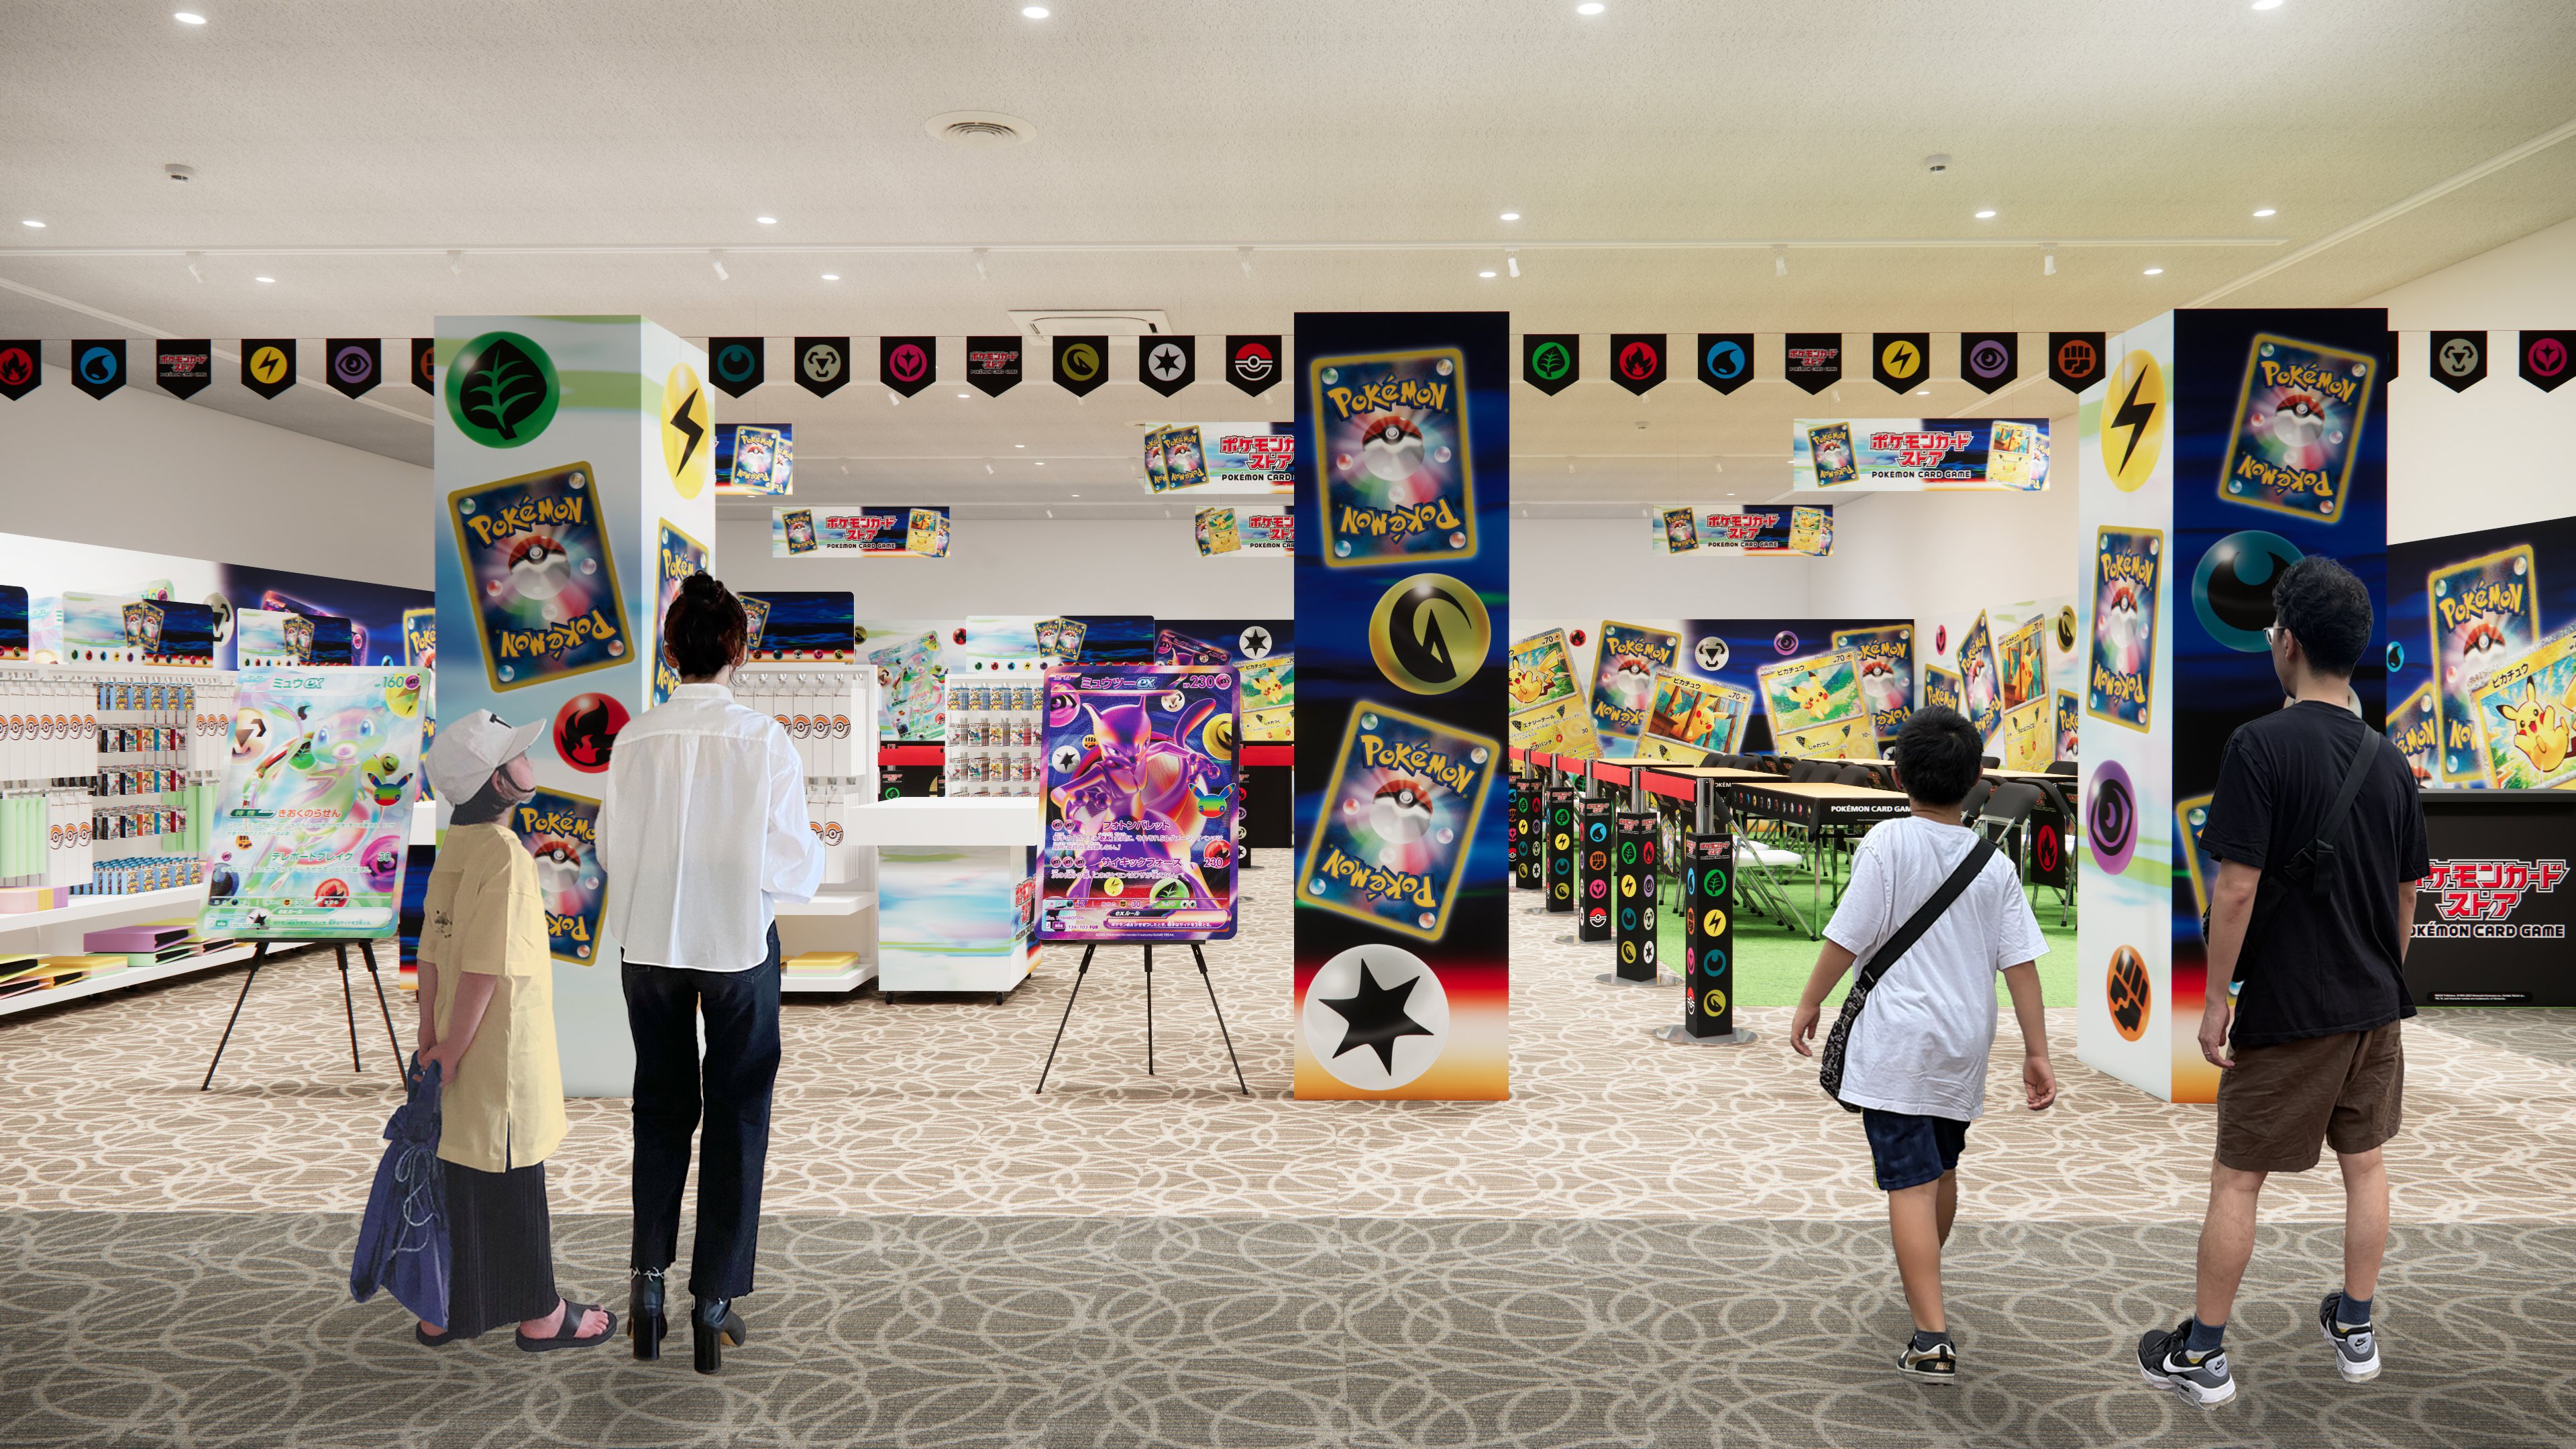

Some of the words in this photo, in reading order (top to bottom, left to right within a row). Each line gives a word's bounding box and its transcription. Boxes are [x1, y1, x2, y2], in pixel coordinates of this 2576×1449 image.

[160, 354, 208, 364] ポケモンカード
[969, 352, 1018, 361] ポケモンカード
[1788, 348, 1838, 358] ポケモンカード
[172, 363, 195, 372] ストア
[982, 360, 1006, 369] ストア
[1801, 358, 1825, 366] ストア
[1220, 435, 1294, 453] ポケモンカ
[1869, 431, 1974, 451] ポケモンカード
[1246, 453, 1294, 470] ストア
[1895, 450, 1946, 468] ストア
[1222, 472, 1264, 481] POKÉMON
[1872, 469, 1915, 478] POKÉMON
[1945, 470, 1972, 478] GAME
[825, 516, 896, 529] ポケモンカード
[1707, 514, 1780, 527] ポケモンカード
[843, 529, 879, 541] ストア
[1267, 527, 1294, 541] スト
[1725, 527, 1760, 540] ストア
[1777, 665, 1805, 676] ピカチュウ
[2492, 663, 2529, 689] ピカチュウ
[383, 676, 404, 689] 160
[1081, 677, 1158, 690] ミュウツーex
[1673, 677, 1701, 690] ピカチュウ
[1523, 714, 1554, 728] エナジーテール
[278, 809, 341, 818] きおくのらせん
[1102, 820, 1171, 831] フォトンバレット
[378, 852, 392, 862] 30
[1101, 857, 1183, 868] サイキックフォース
[1203, 857, 1224, 868] 230
[2439, 891, 2520, 919] ストア
[2411, 922, 2470, 937] OKÉMON
[2473, 925, 2517, 938] CARD
[2520, 925, 2564, 938] GAME
